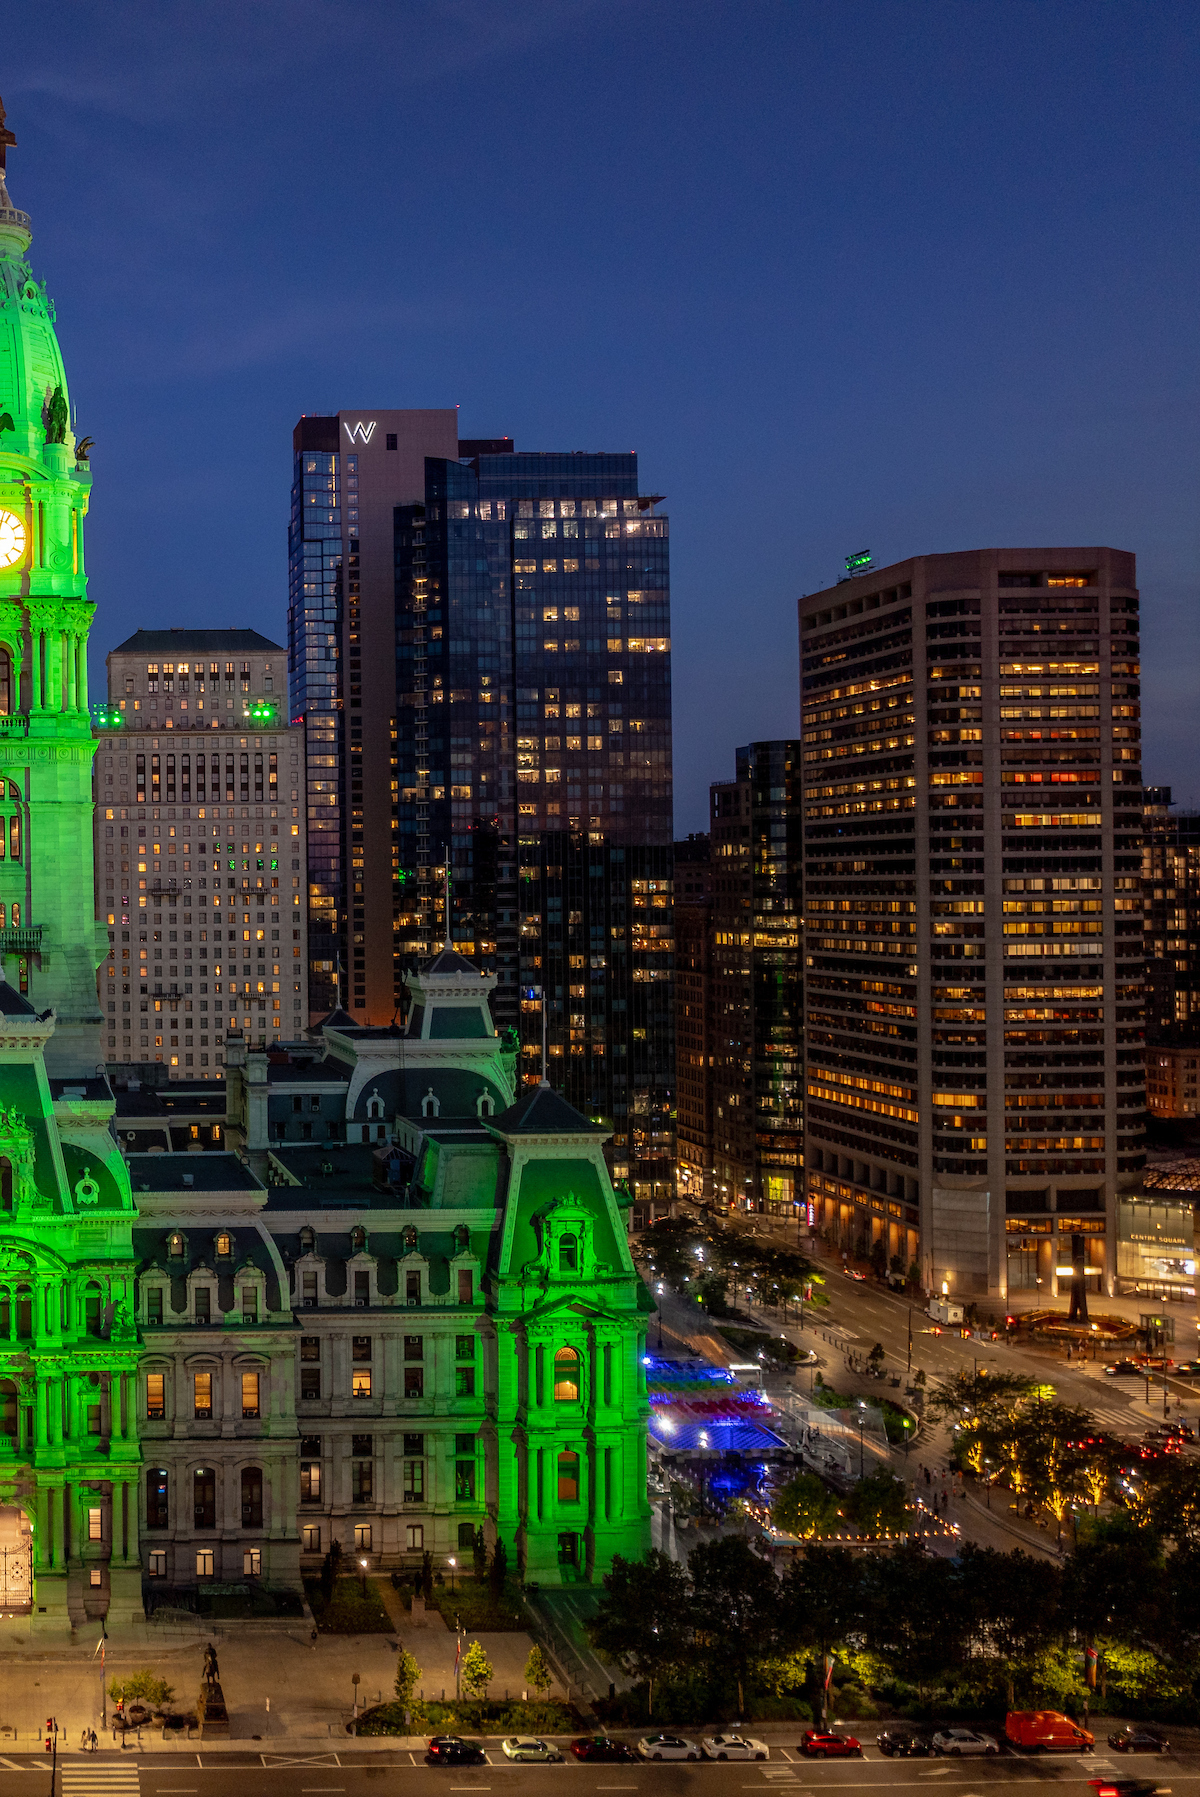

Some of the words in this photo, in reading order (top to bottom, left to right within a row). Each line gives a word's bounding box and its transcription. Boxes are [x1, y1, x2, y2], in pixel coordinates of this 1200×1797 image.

[343, 421, 377, 444] W
[1130, 1234, 1157, 1242] CENTRE
[1158, 1236, 1187, 1245] SQUARE
